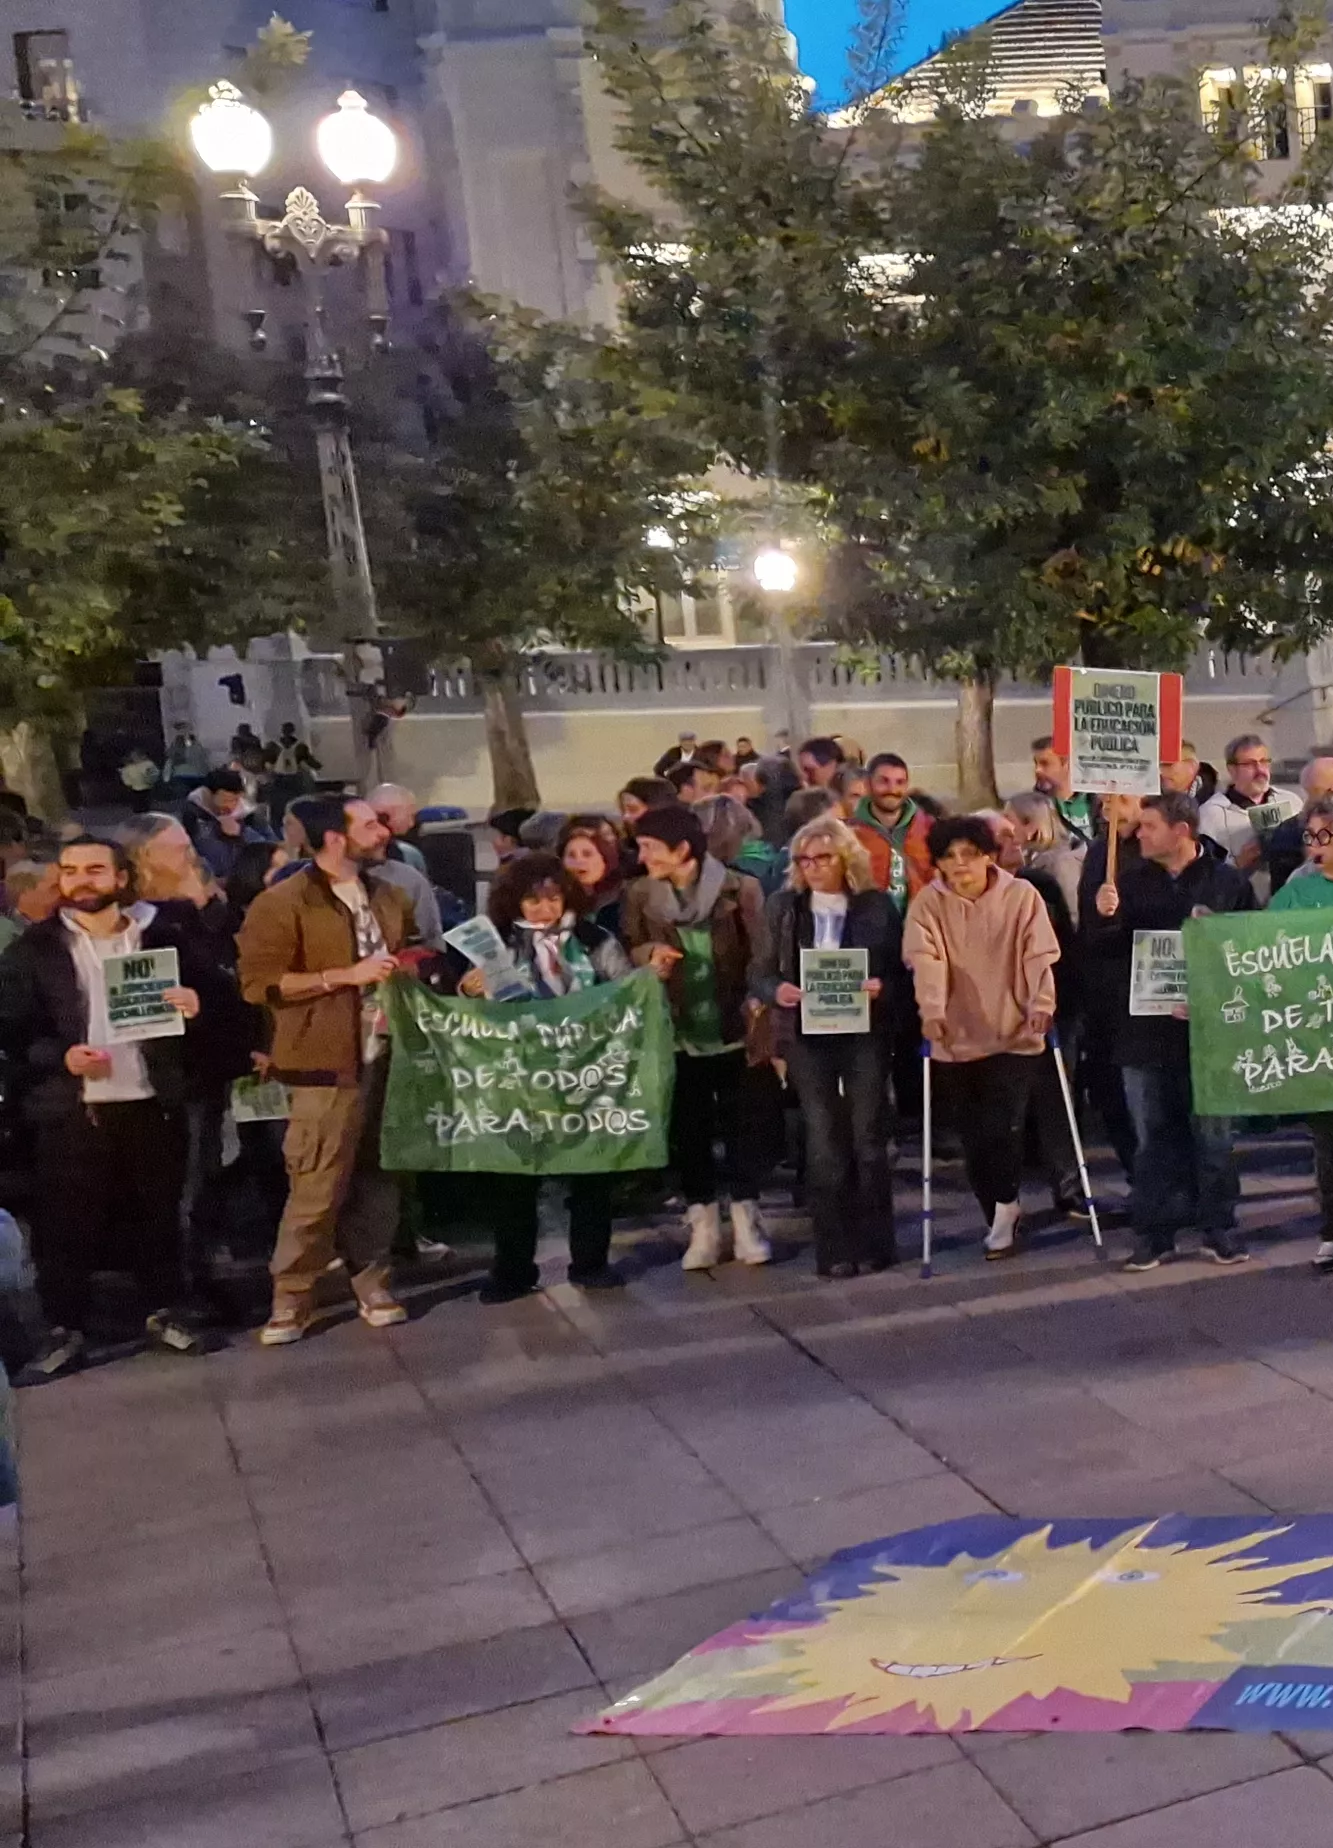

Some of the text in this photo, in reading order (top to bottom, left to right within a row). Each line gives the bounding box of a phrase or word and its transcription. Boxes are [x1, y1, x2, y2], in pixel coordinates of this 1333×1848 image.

[123, 956, 155, 979] NO!
[1262, 1003, 1302, 1033] DE
[452, 1065, 496, 1089] DE
[435, 1107, 651, 1146] PARA TOD@S
